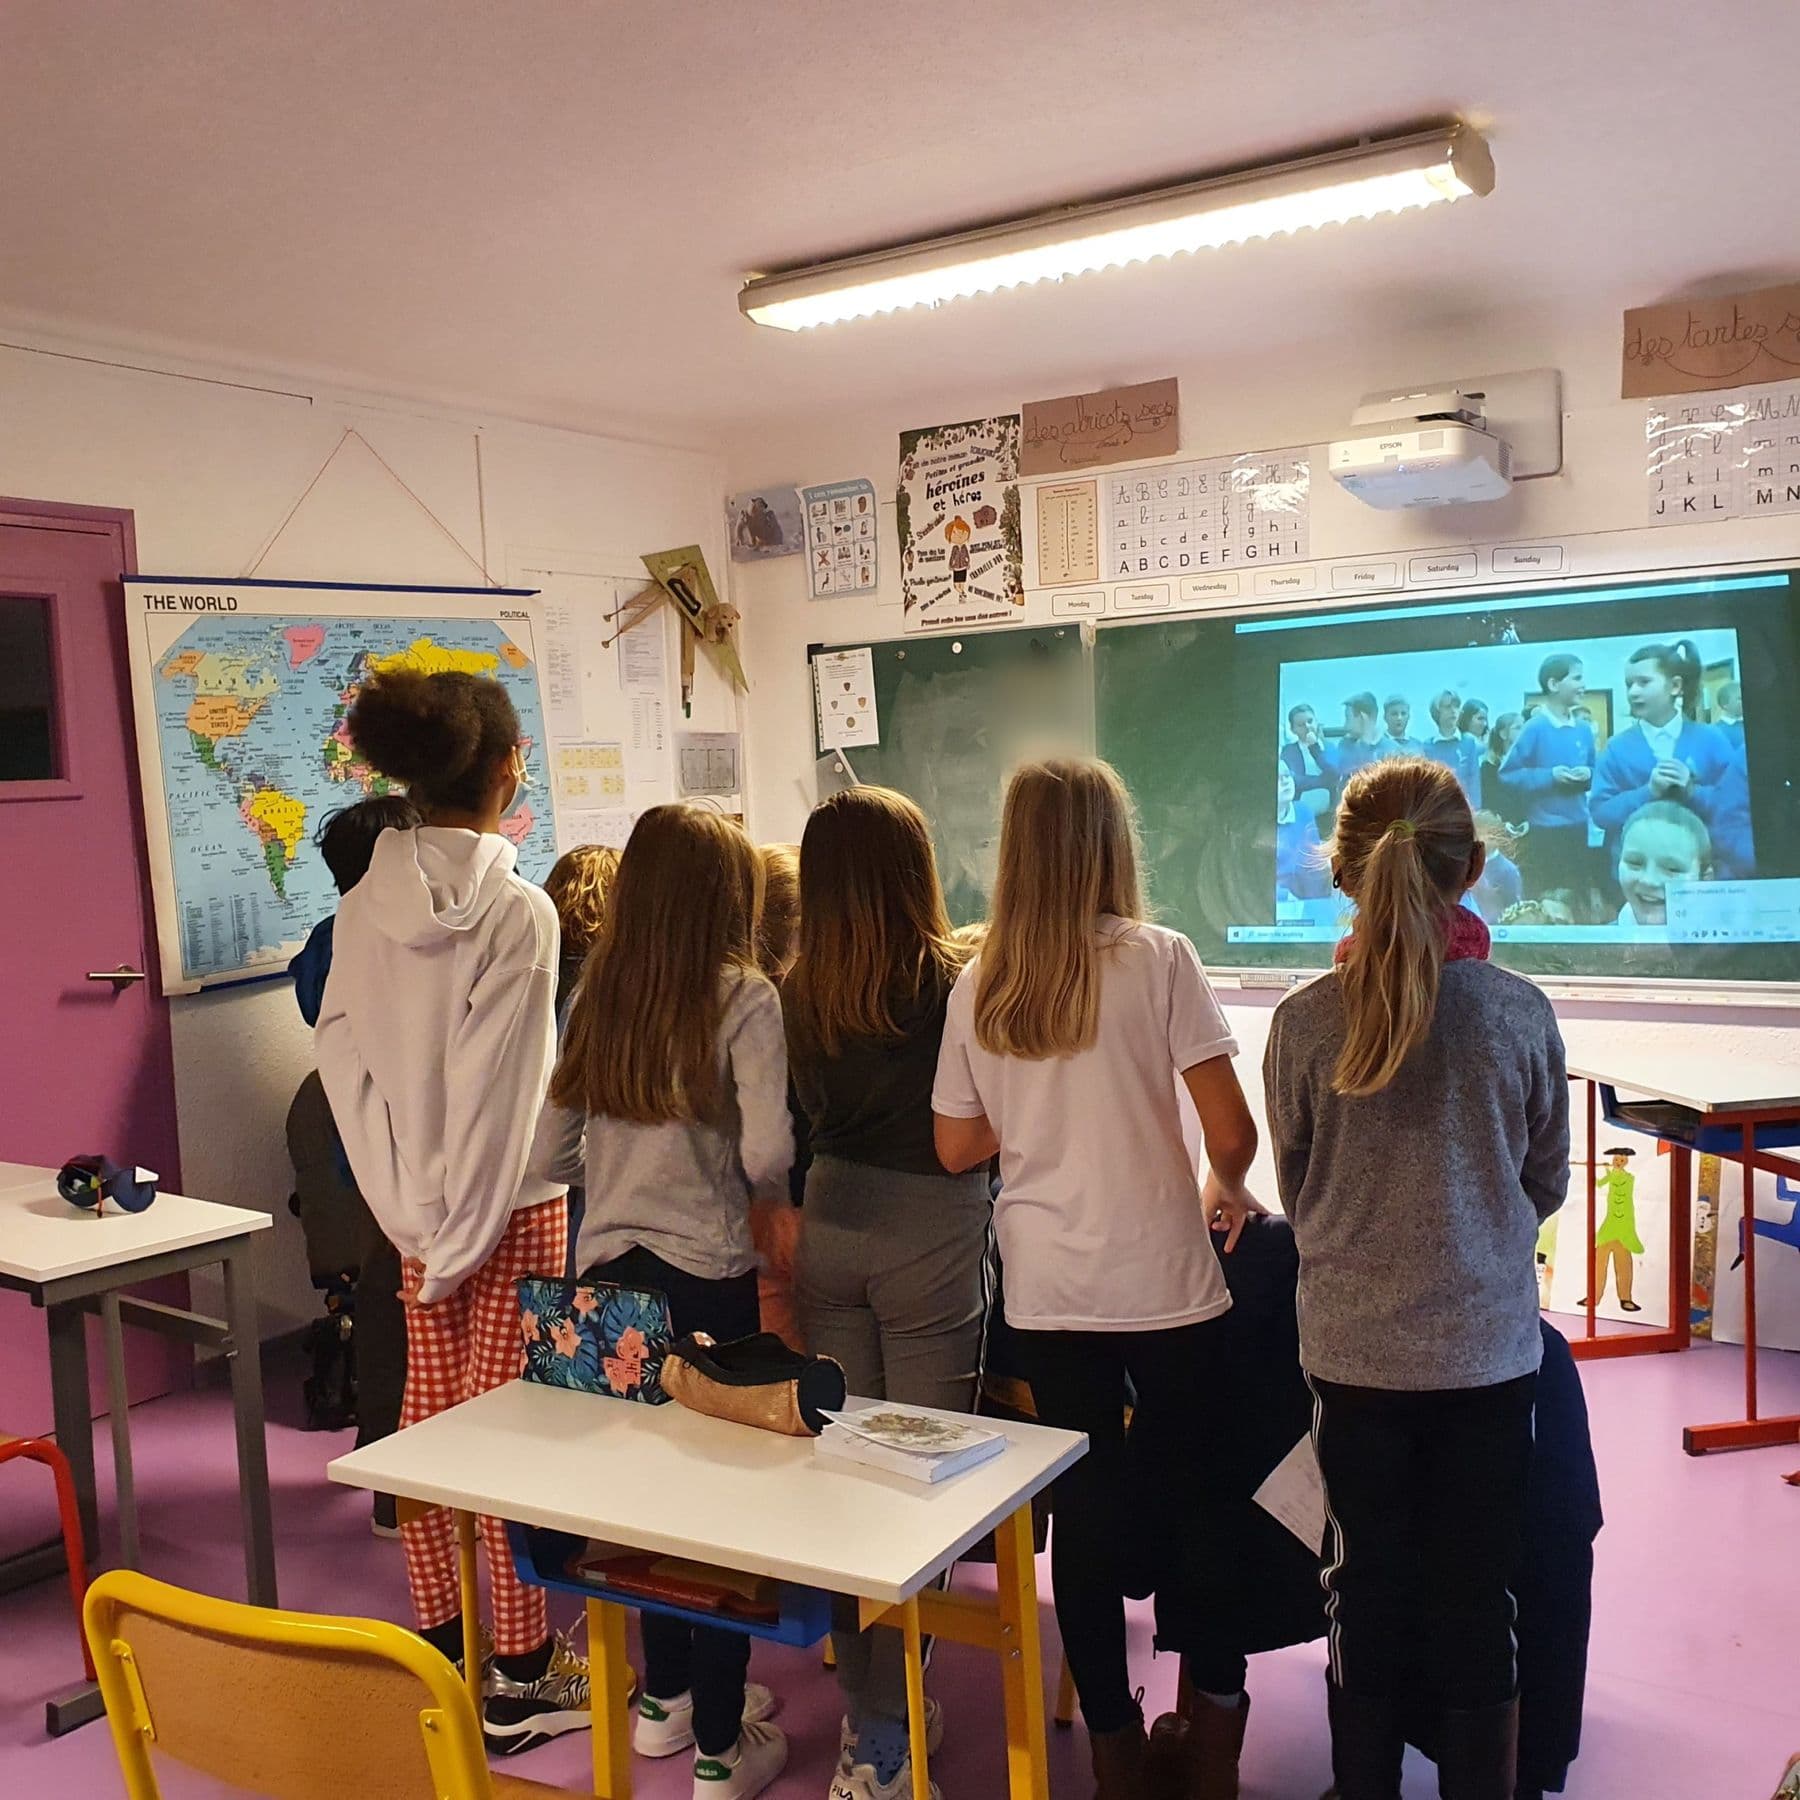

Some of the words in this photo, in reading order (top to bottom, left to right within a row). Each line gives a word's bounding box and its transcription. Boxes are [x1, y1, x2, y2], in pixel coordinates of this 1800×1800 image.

[1624, 328, 1674, 361] des
[1680, 304, 1769, 349] tartes
[1024, 415, 1060, 444] des
[1062, 395, 1131, 436] abricots
[1379, 441, 1403, 450] EPSON
[926, 471, 986, 500] héroïnes
[933, 499, 946, 512] et
[952, 490, 982, 506] héros
[1656, 500, 1665, 515] J
[1684, 496, 1697, 513] K
[1713, 494, 1724, 509] L
[1757, 488, 1773, 505] M
[1119, 560, 1130, 574] A
[1139, 557, 1149, 571] B
[1159, 555, 1169, 569] C
[1179, 553, 1190, 567] D
[1200, 551, 1210, 565] E
[1222, 549, 1231, 562] F
[1246, 545, 1257, 559] G
[1269, 543, 1280, 557] H
[1513, 556, 1541, 565] Sunday
[1427, 563, 1460, 574] Saturday
[1270, 577, 1301, 586] Thursday
[1354, 572, 1376, 581] Friday
[1192, 582, 1227, 592] Wednesday
[143, 594, 178, 611] THE
[179, 595, 238, 611] WORLD
[1131, 593, 1154, 602] Tuesday
[1068, 601, 1090, 609] Monday
[499, 610, 530, 619] POLITICAL
[831, 1784, 855, 1800] FILA
